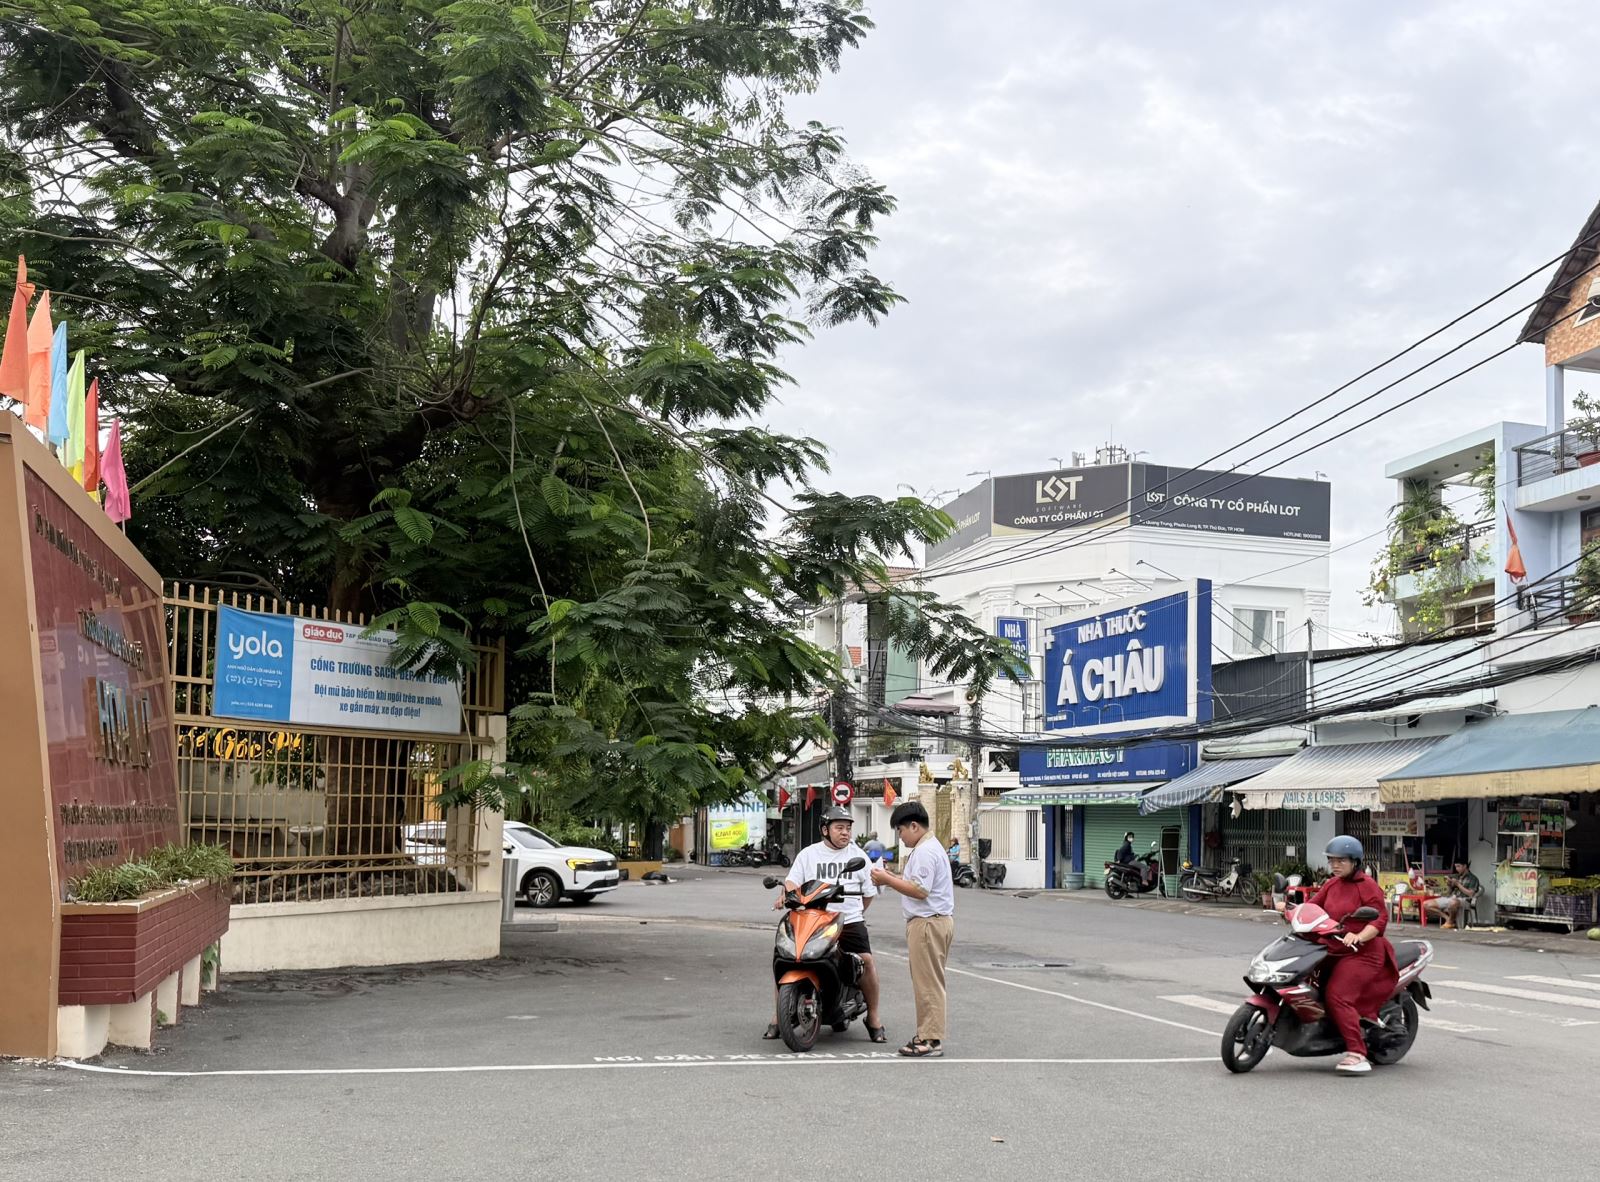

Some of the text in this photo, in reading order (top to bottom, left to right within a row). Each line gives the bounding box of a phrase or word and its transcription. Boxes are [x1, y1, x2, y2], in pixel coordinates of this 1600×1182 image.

[1036, 475, 1083, 504] LOT
[1146, 491, 1165, 503] LOT
[1173, 494, 1300, 516] CÔNG TY CỔ PHẦN LOT
[1014, 513, 1038, 525] CÔNG
[1039, 515, 1051, 523] TY
[304, 626, 325, 638] giáo
[326, 629, 343, 641] dục
[1004, 621, 1021, 638] NHÀ
[1078, 606, 1147, 644] NHÀ THUỐC
[228, 630, 283, 660] yola
[338, 659, 372, 677] TRƯỜNG
[1056, 638, 1165, 706] Á CHÂU
[376, 689, 387, 701] khi
[416, 695, 425, 705] xe
[339, 702, 349, 712] xe
[381, 705, 390, 715] xe
[1046, 746, 1124, 768] PHARMACY
[1282, 792, 1346, 804] NAILS & LASHES
